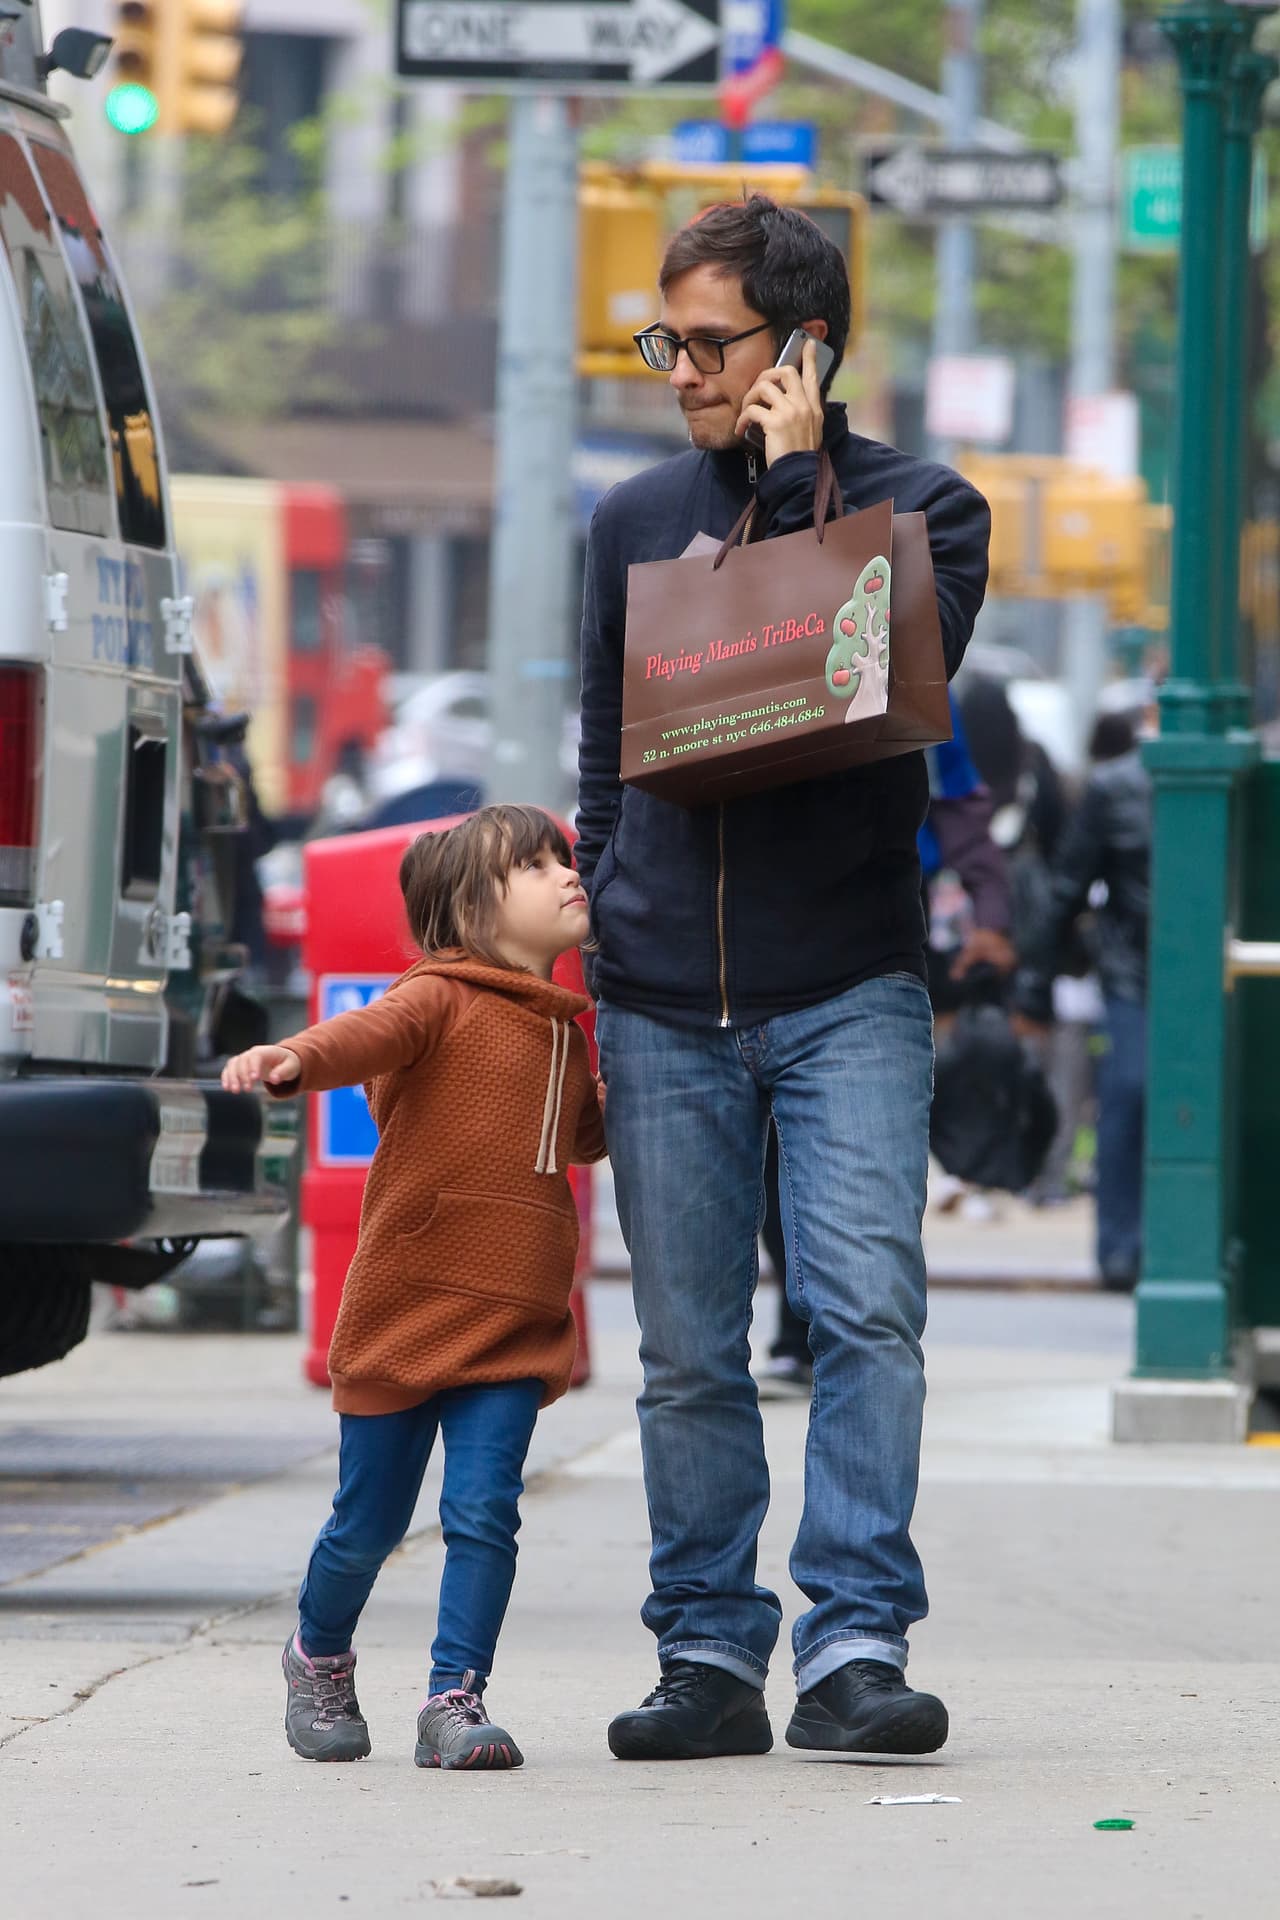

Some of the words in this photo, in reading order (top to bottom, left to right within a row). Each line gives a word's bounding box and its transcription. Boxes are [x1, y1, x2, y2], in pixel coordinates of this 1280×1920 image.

[420, 14, 512, 50] ONE
[645, 648, 704, 681] Playing
[706, 631, 757, 663] Mantis
[762, 612, 825, 648] TriBeCa
[642, 749, 657, 763] 32
[660, 750, 670, 759] n.
[673, 738, 709, 755] moore
[712, 734, 723, 745] st
[726, 729, 747, 743] nyc
[749, 704, 825, 735] 646.484.6845
[661, 697, 807, 741] www.playing-mantis.com
